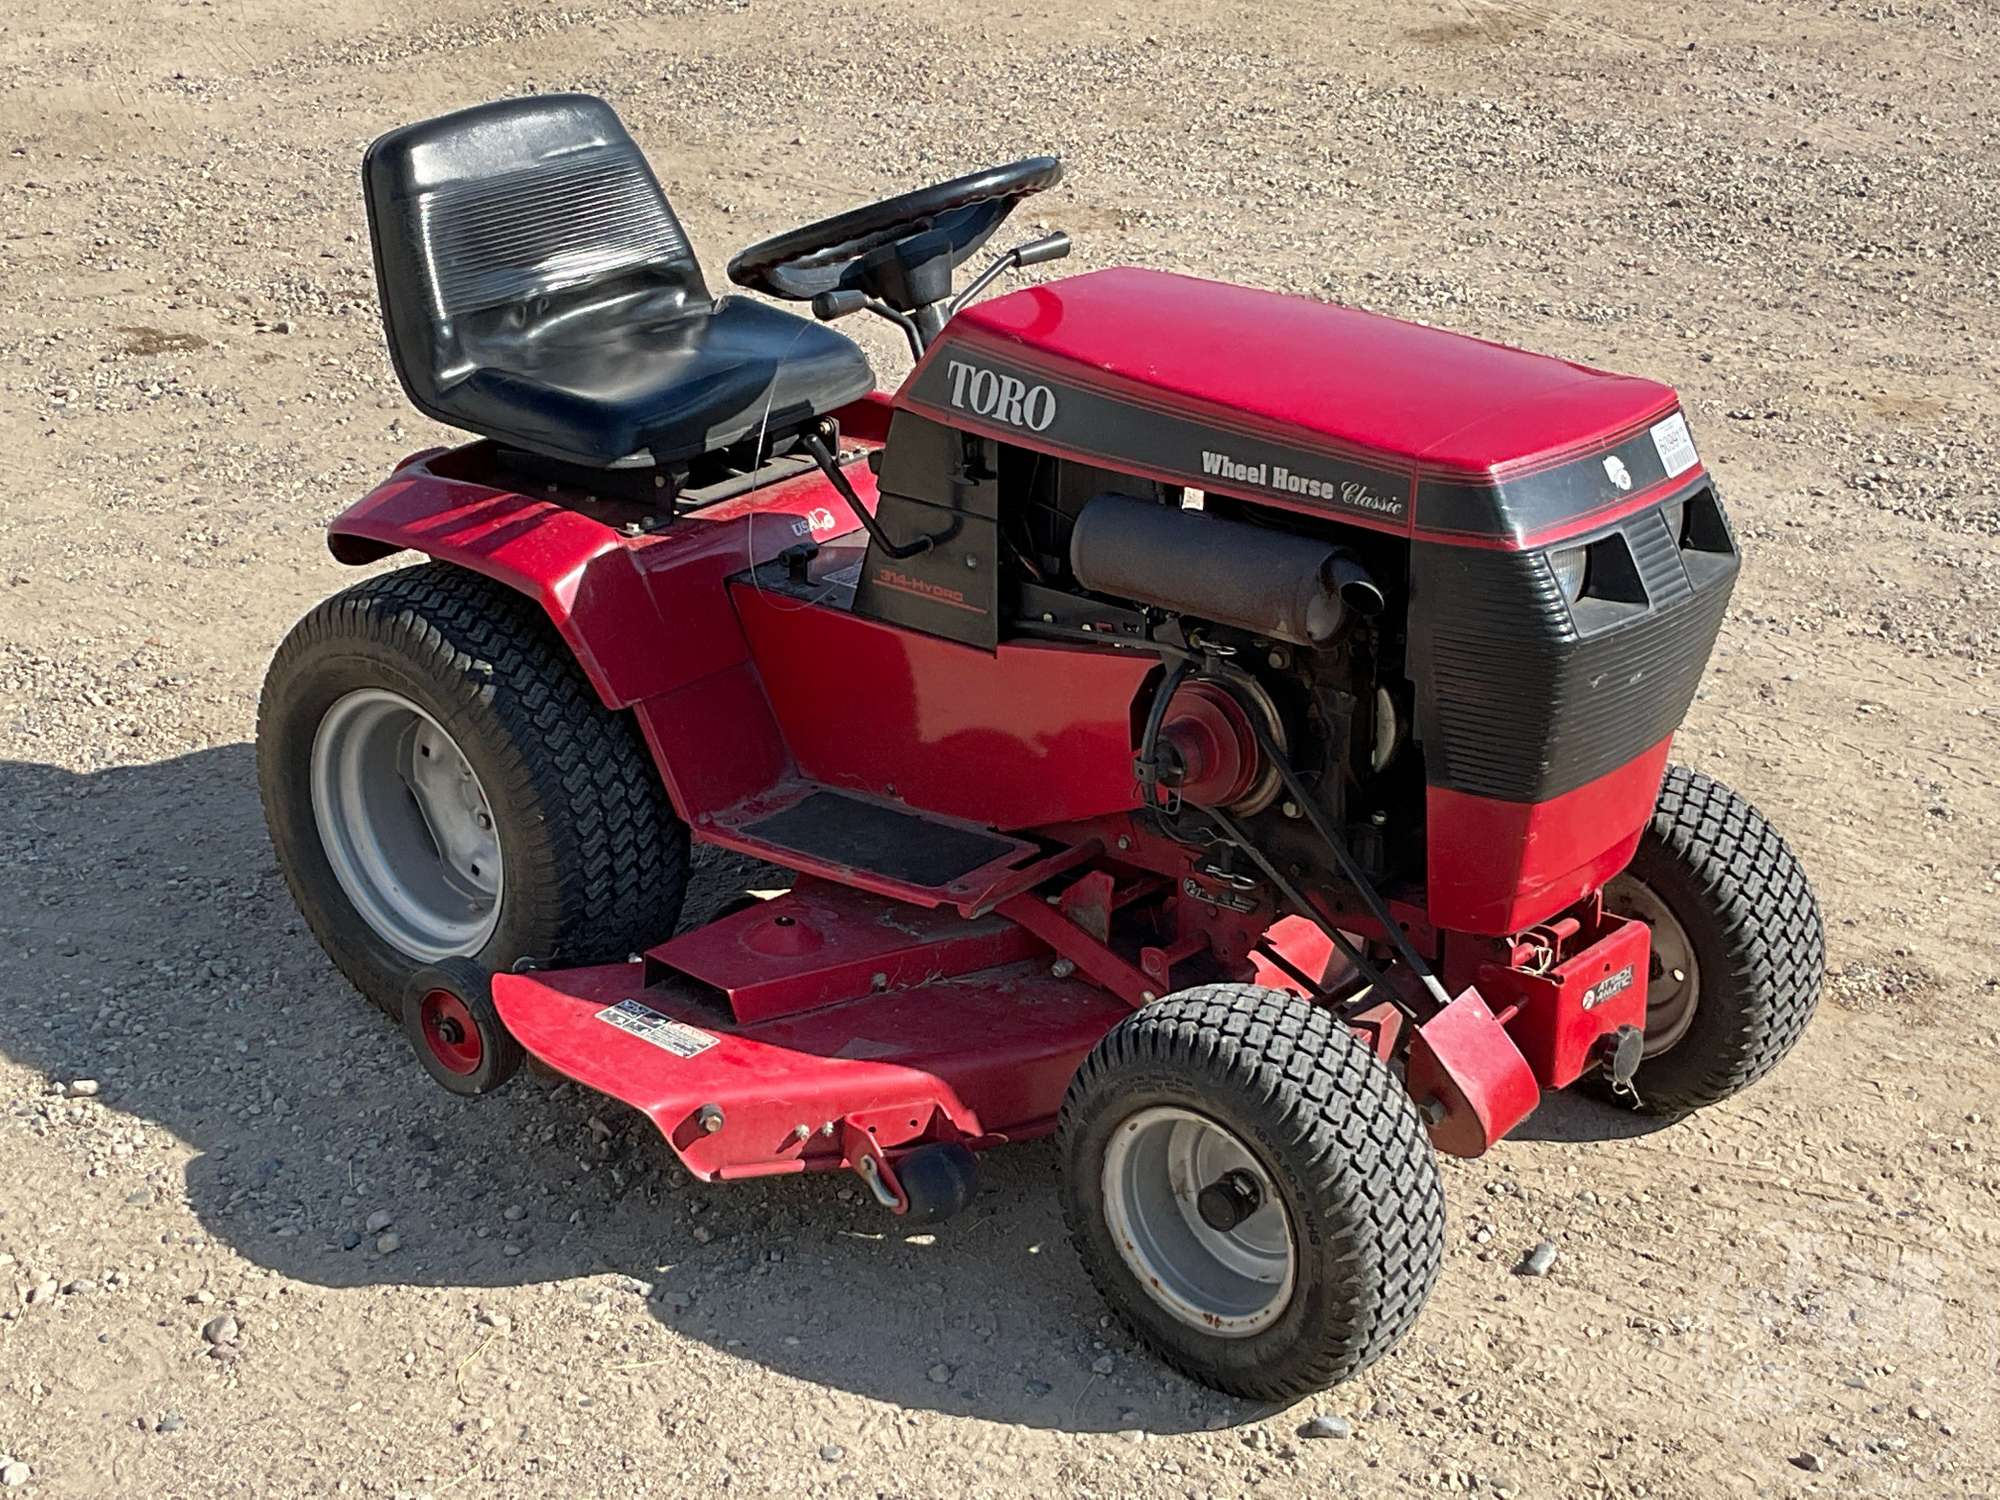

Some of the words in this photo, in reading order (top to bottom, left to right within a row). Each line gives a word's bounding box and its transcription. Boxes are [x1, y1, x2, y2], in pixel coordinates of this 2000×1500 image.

[947, 359, 1056, 431] TORO
[1202, 450, 1267, 486] Wheel
[1272, 466, 1334, 500] Horse
[1340, 480, 1403, 516] Classic
